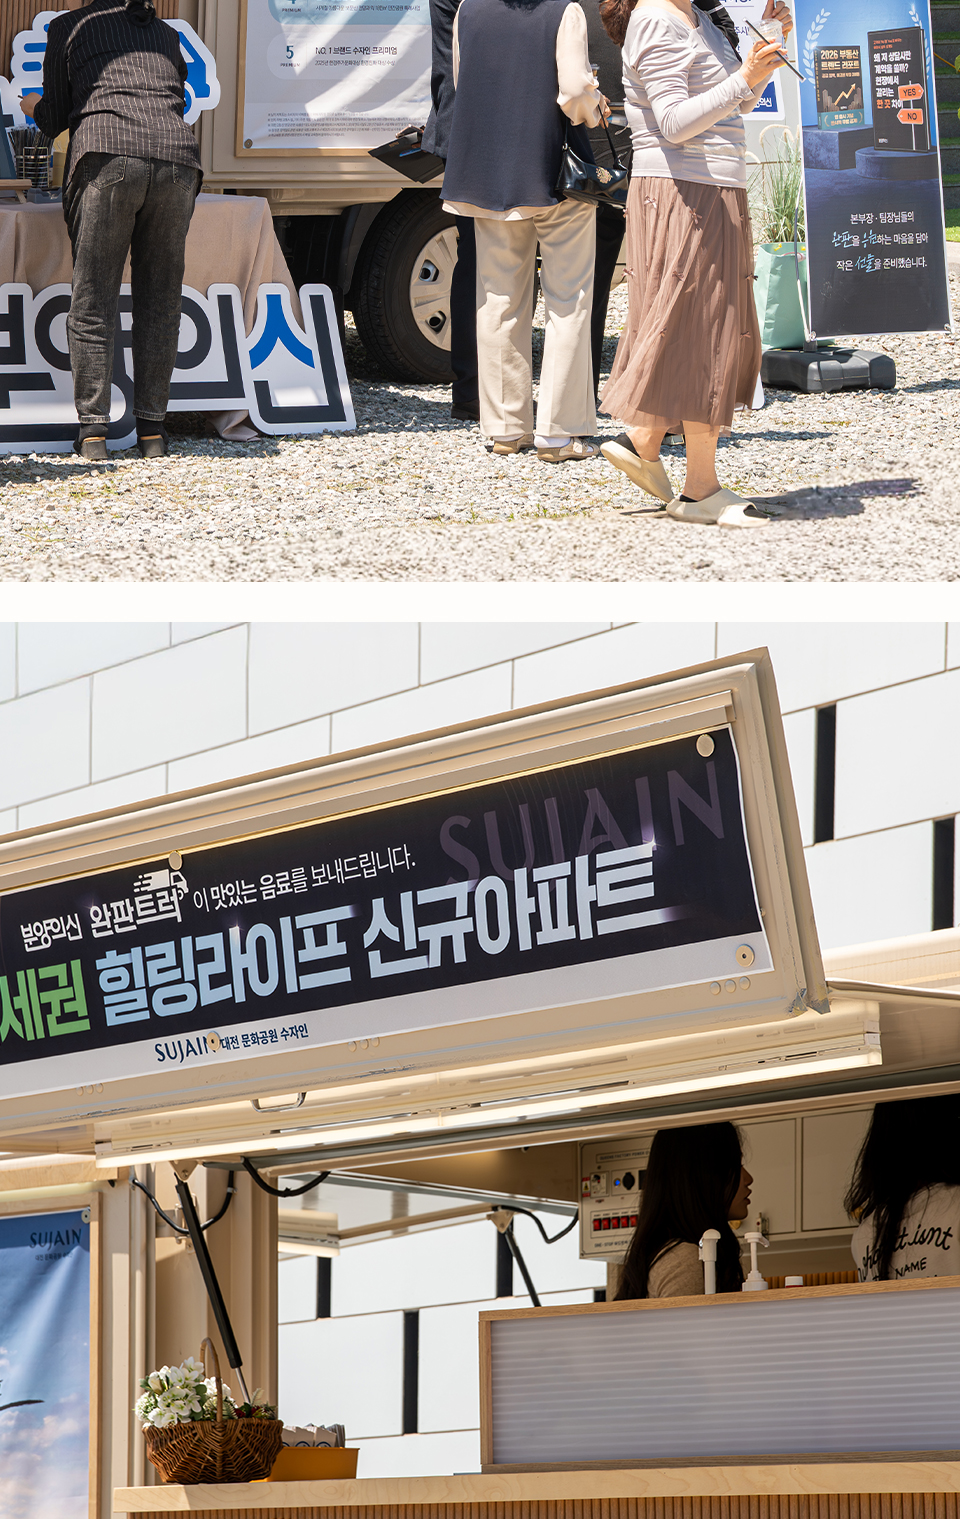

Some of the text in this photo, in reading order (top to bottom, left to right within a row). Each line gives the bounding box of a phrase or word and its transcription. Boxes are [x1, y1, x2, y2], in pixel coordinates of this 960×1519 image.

[285, 45, 294, 60] 5
[328, 47, 333, 55] 1
[333, 46, 352, 55] 브랜드
[352, 46, 371, 55] 수자인
[371, 47, 398, 56] 프리미엄
[902, 88, 917, 97] YES
[907, 112, 918, 120] NO
[849, 211, 915, 225] 본부장 팀장님들의
[831, 230, 861, 249] 완판을
[893, 232, 915, 245] 마음을
[915, 232, 929, 244] 담아
[836, 253, 928, 273] 작은 선물을 준비했습니다.
[440, 761, 725, 885] SUJAIN
[19, 843, 417, 953] 분양의신 완판트럭 이 맛있는 음료를 보내드립니다.
[95, 904, 357, 1027] 힐링라이프
[362, 841, 680, 979] 신규아파트
[220, 1022, 309, 1052] 대전 문화공원 수자인
[29, 1227, 83, 1252] SUJAIN
[895, 1256, 927, 1280] NAME
